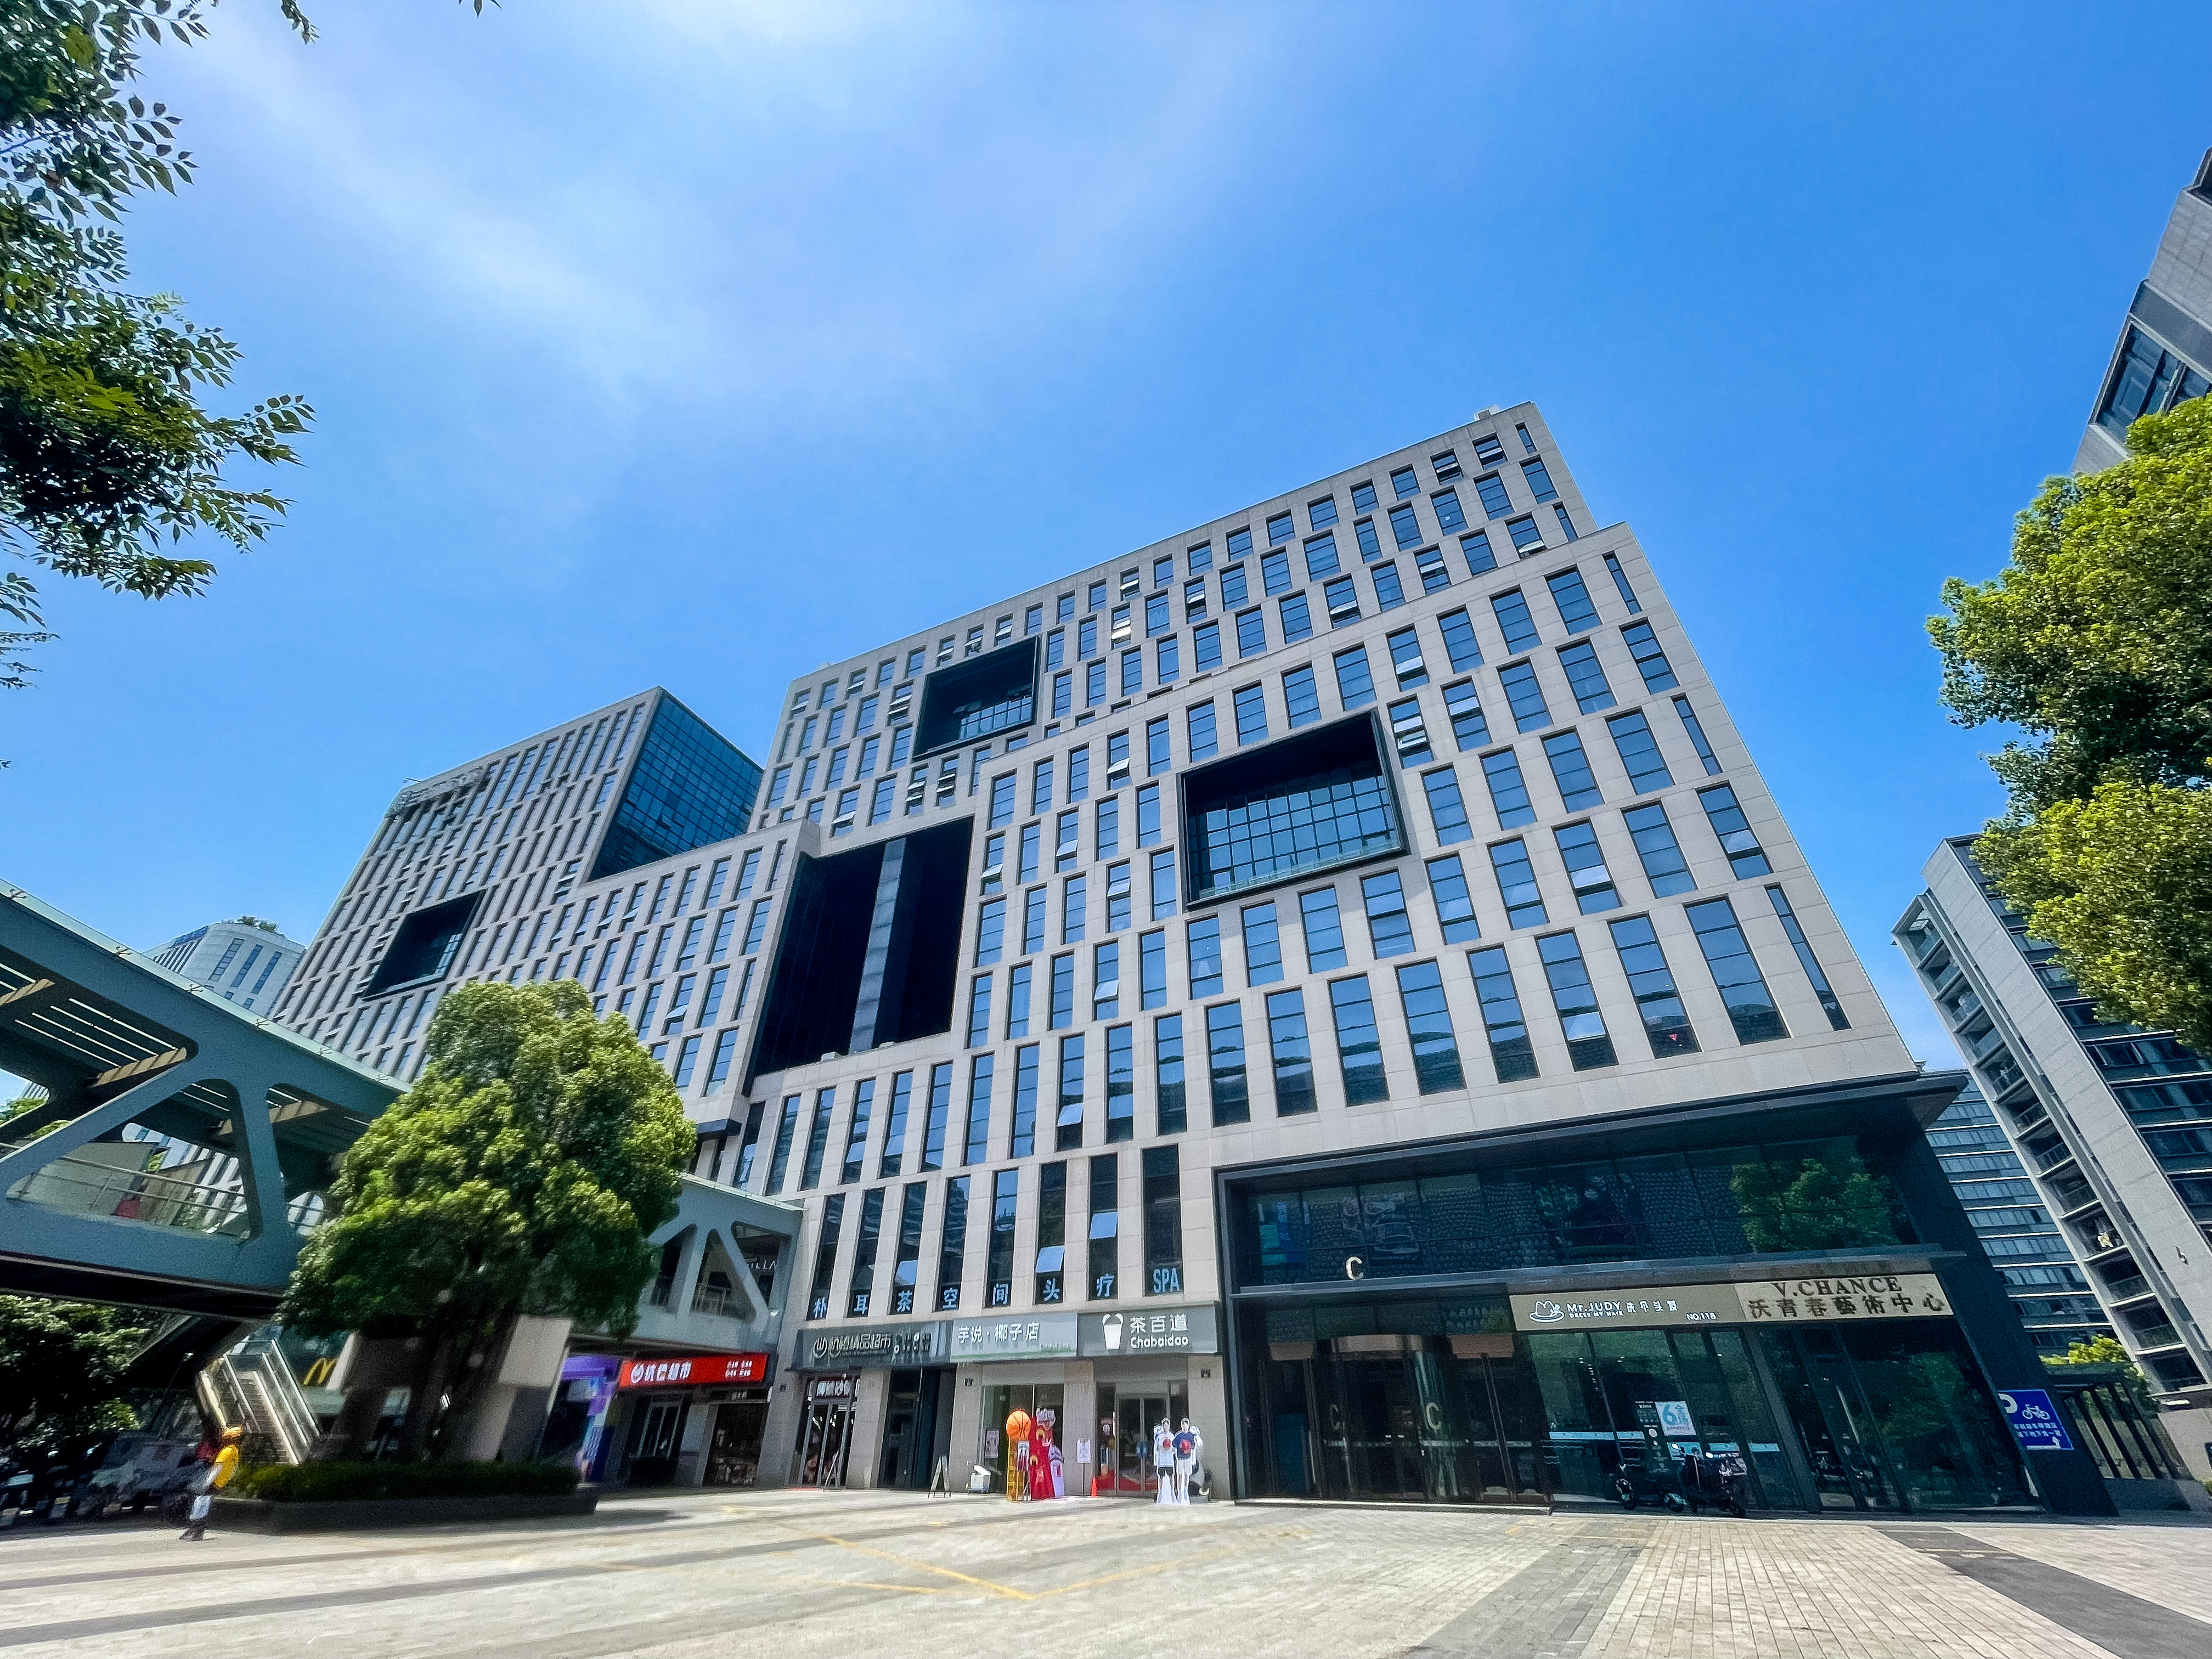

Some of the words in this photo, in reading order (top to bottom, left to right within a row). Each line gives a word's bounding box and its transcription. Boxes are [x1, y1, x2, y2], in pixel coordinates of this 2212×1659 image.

[1346, 1256, 1364, 1280] C
[1153, 1267, 1180, 1294] SPA
[1772, 1276, 1903, 1297] V.CHANCE
[1566, 1301, 1621, 1312] Mr.JUDY
[1130, 1313, 1188, 1334] 茶百道
